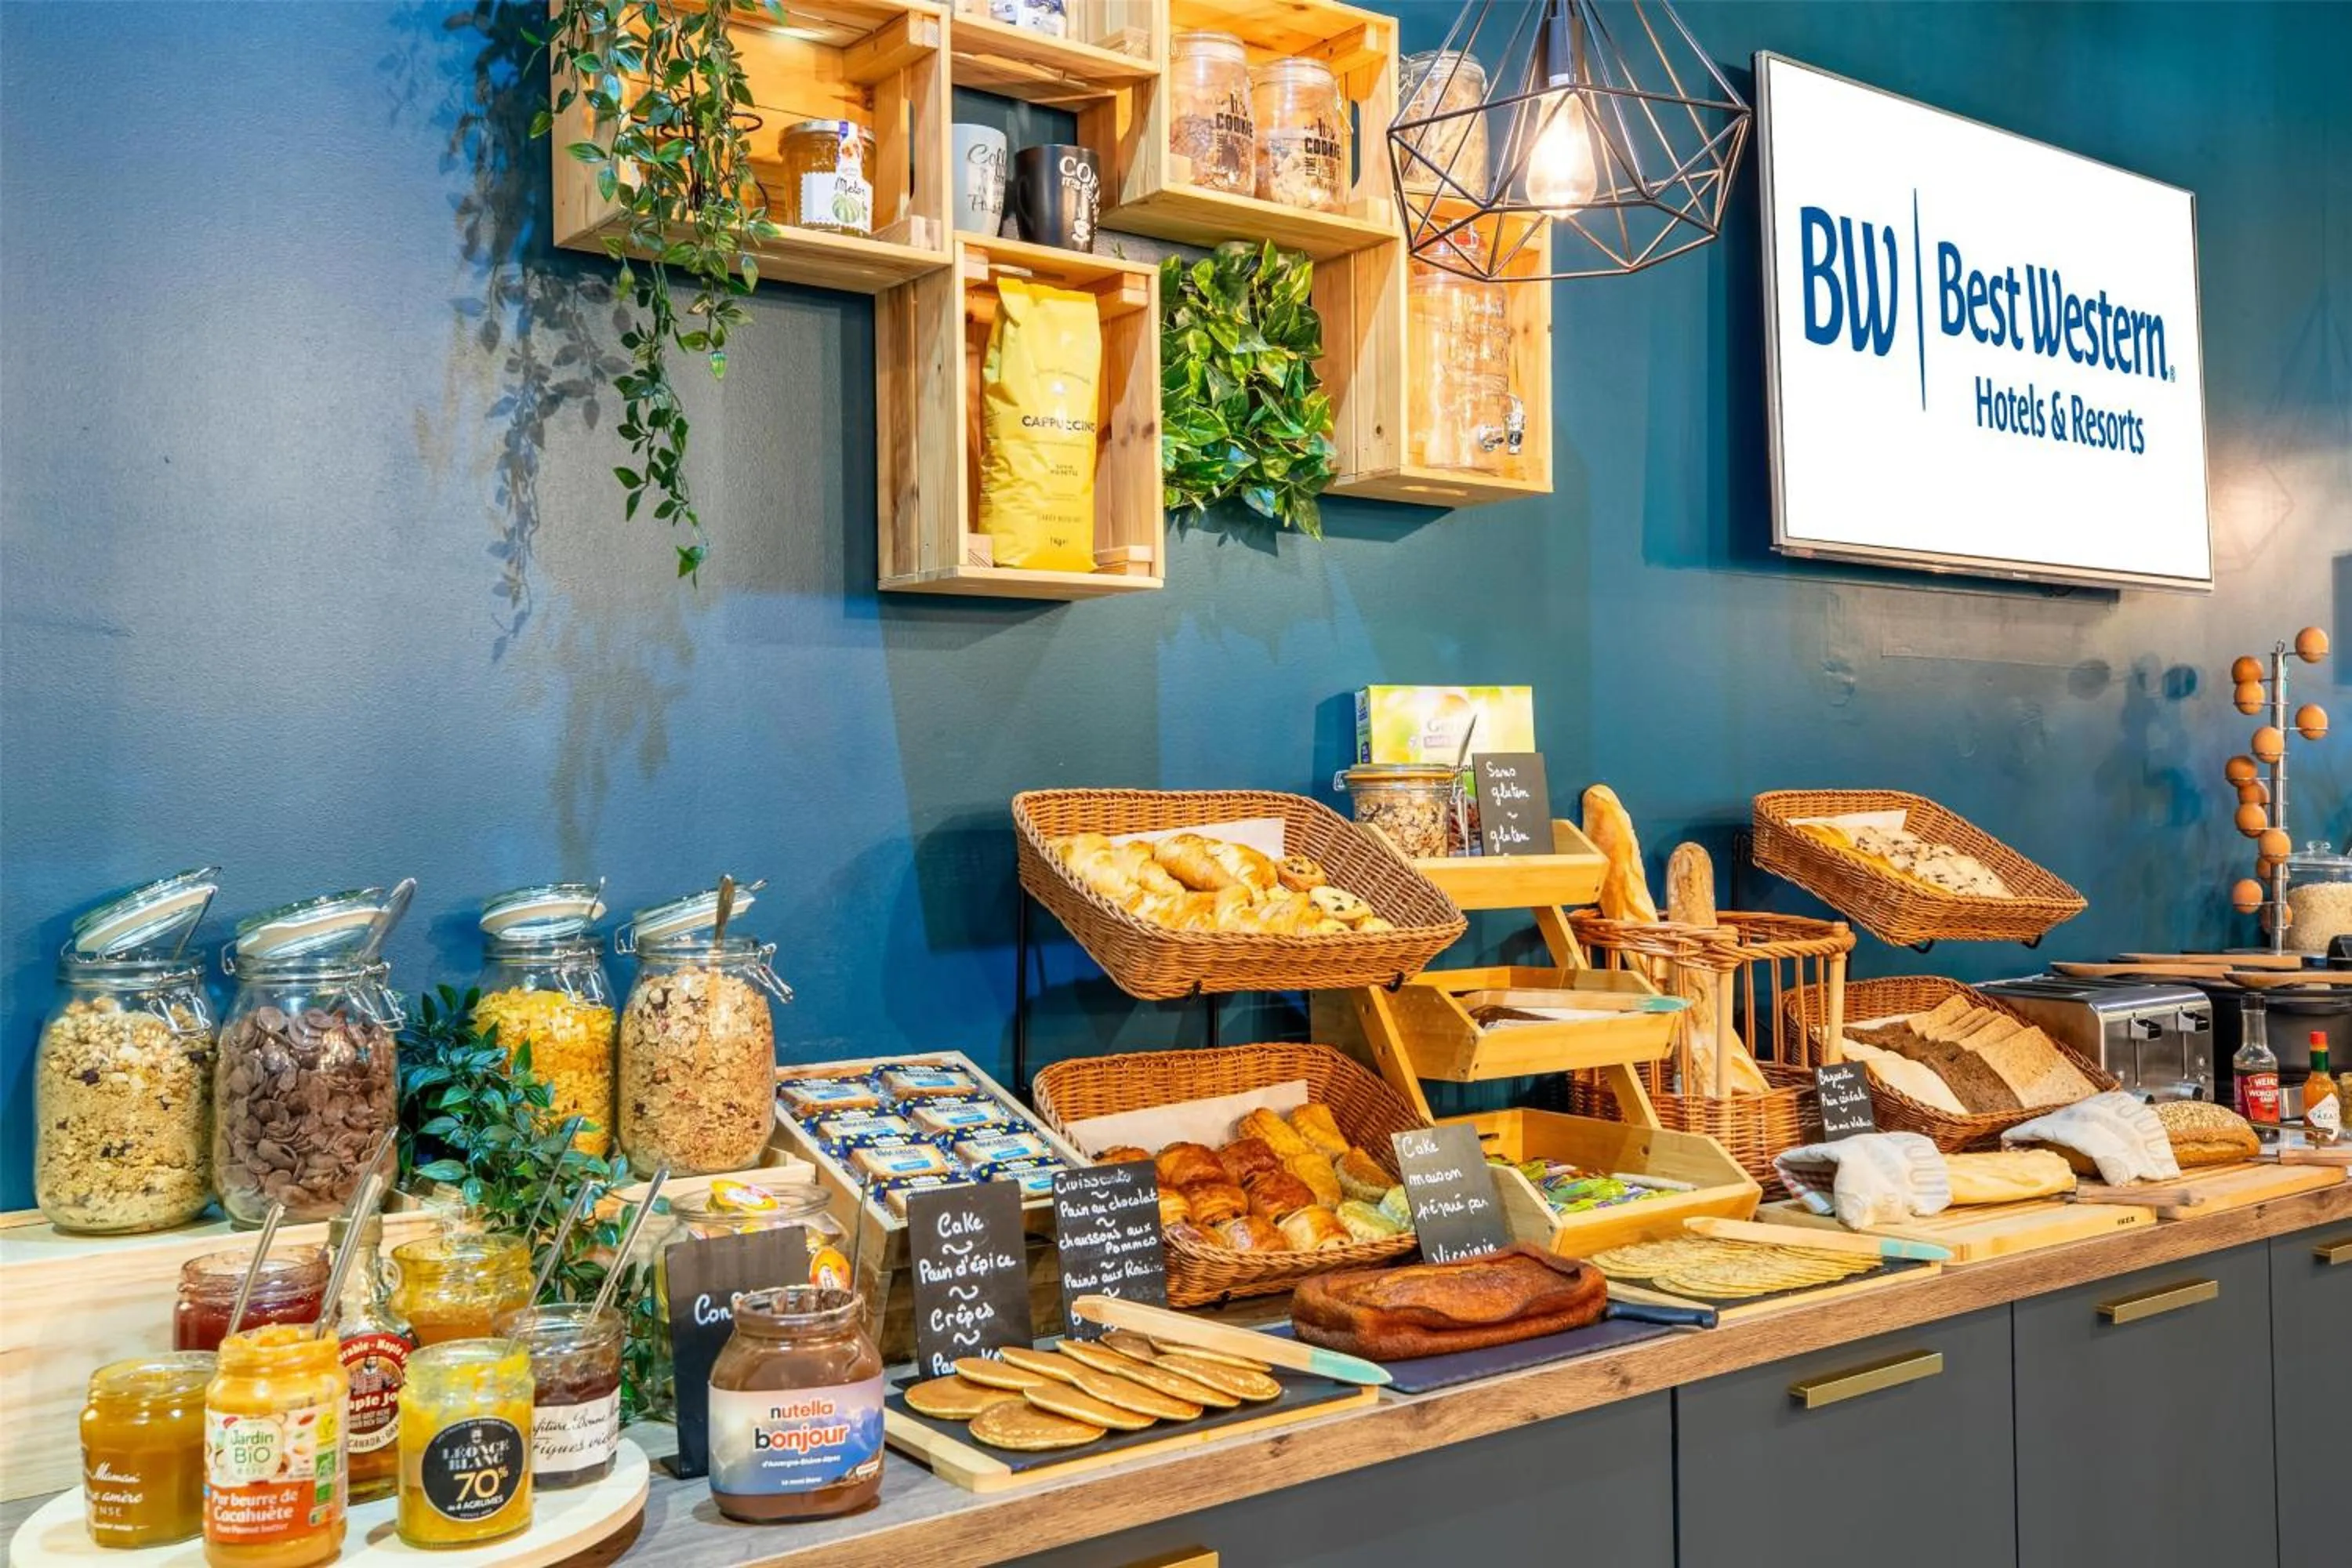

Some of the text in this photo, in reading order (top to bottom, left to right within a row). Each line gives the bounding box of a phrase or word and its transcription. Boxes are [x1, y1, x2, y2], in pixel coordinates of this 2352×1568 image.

[1800, 205, 1898, 357] BW
[1937, 240, 2169, 381] Best Western
[1975, 375, 2145, 456] Hotels & Resorts
[1409, 1167, 1463, 1185] maison
[1060, 1187, 1158, 1218] Pain au chocolat
[1468, 1198, 1489, 1214] par
[1127, 1222, 1152, 1236] aux
[918, 1252, 1017, 1284] Pain d'épice
[1102, 1269, 1123, 1283] aux
[931, 1301, 995, 1331] Crêpes
[771, 1399, 834, 1419] nutella
[230, 1429, 274, 1445] Jardin
[755, 1425, 849, 1452] bonjour
[230, 1491, 278, 1508] beurre
[280, 1488, 299, 1504] de
[214, 1504, 296, 1523] Cacahuète
